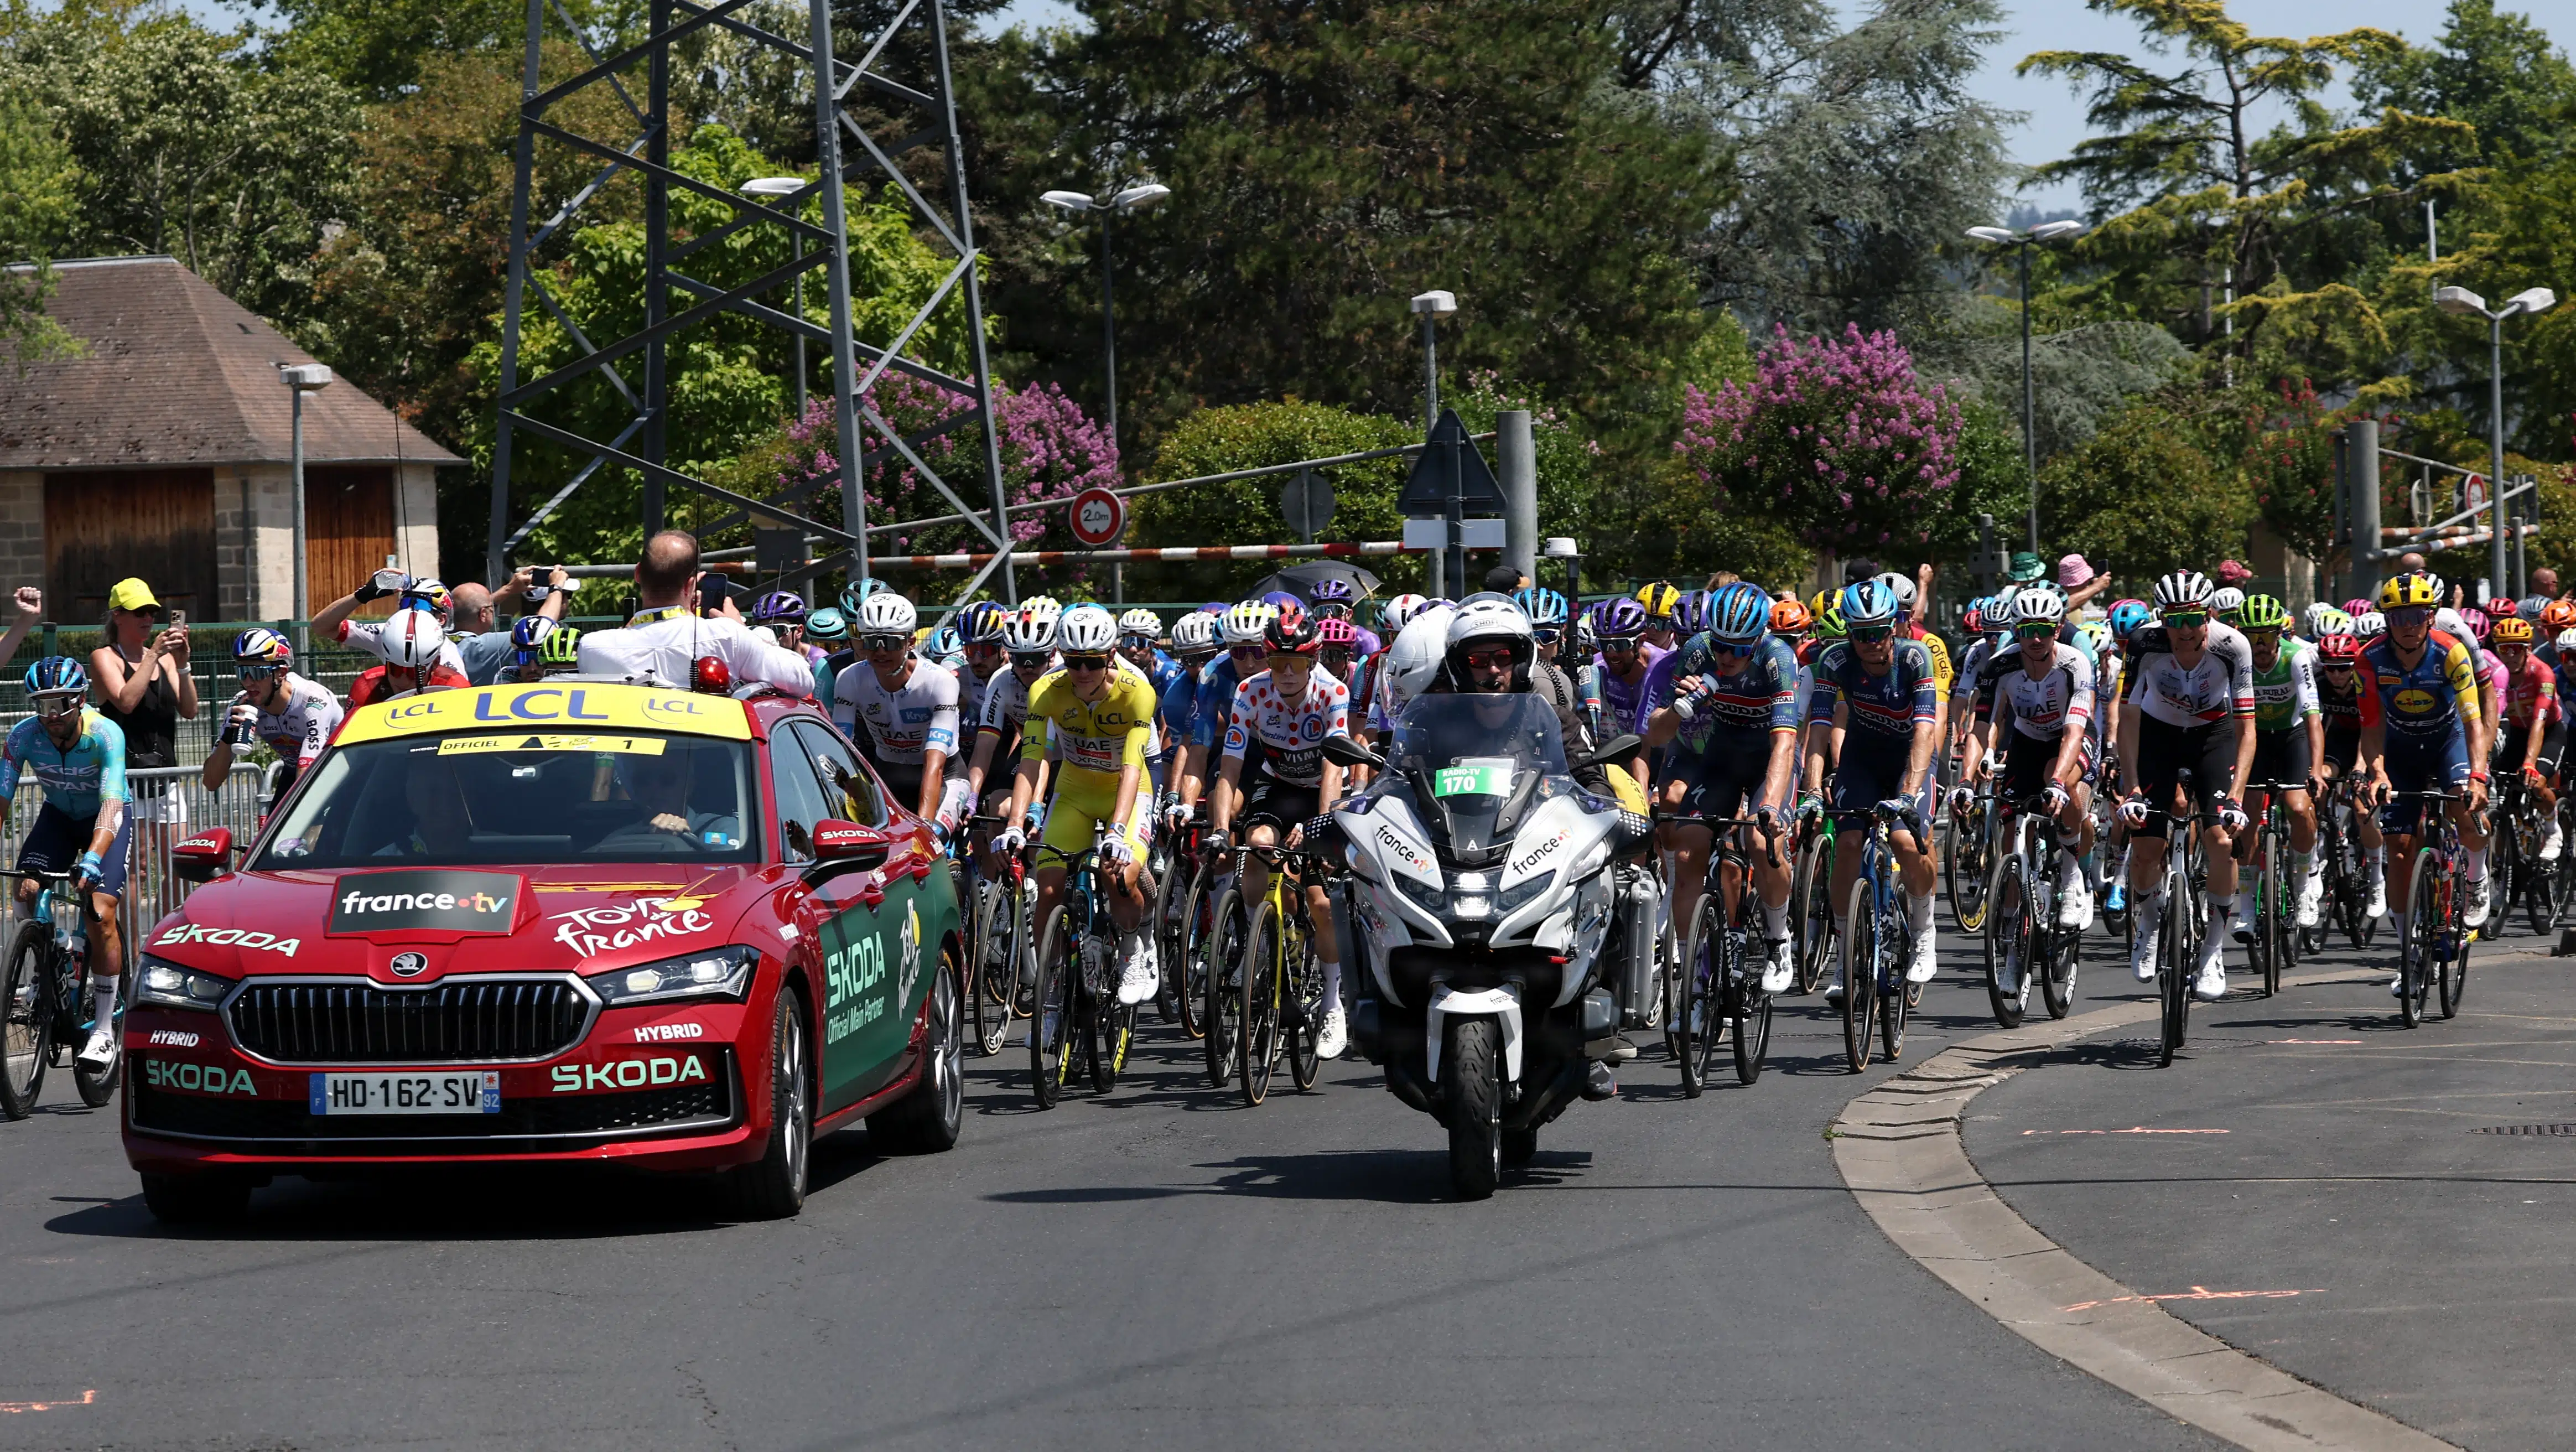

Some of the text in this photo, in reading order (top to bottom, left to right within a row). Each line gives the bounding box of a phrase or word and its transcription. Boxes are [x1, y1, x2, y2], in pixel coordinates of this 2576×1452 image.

[922, 662, 938, 671] Krys
[2377, 665, 2401, 676] Santini
[1120, 675, 1137, 687] LCL
[2302, 664, 2312, 690] RGA
[1853, 691, 1879, 700] Ekopak
[2263, 687, 2291, 696] RURAL
[307, 696, 328, 708] BORA
[475, 689, 609, 721] LCL
[648, 698, 703, 715] LCL
[986, 688, 1002, 725] GIANT
[1642, 685, 1658, 730] GIANT
[390, 702, 443, 719] LCL
[2017, 699, 2059, 718] UAE
[2324, 703, 2359, 715] TUDO
[906, 712, 929, 723] Krys
[1098, 713, 1129, 725] LCL
[306, 719, 319, 751] BOSS
[879, 730, 923, 740] UAE
[444, 740, 500, 750] OFFICIEL
[623, 740, 633, 750] 1
[1074, 738, 1111, 750] UAE
[1077, 756, 1112, 768] XRG
[1442, 768, 1481, 777] RADIO-TV
[1443, 776, 1476, 793] 170
[820, 829, 880, 840] SKODA
[175, 839, 216, 848] SKODA
[153, 924, 301, 958] SKODA
[827, 931, 885, 1008] SKODA
[828, 1009, 850, 1045] Official
[850, 1003, 864, 1034] Main
[864, 996, 885, 1024] Partner
[150, 1030, 199, 1047] HYBRID
[633, 1023, 703, 1043] HYBRID
[146, 1060, 258, 1096] SKODA
[551, 1055, 706, 1092] SKODA
[315, 1098, 321, 1106] F
[484, 1094, 499, 1107] 92
